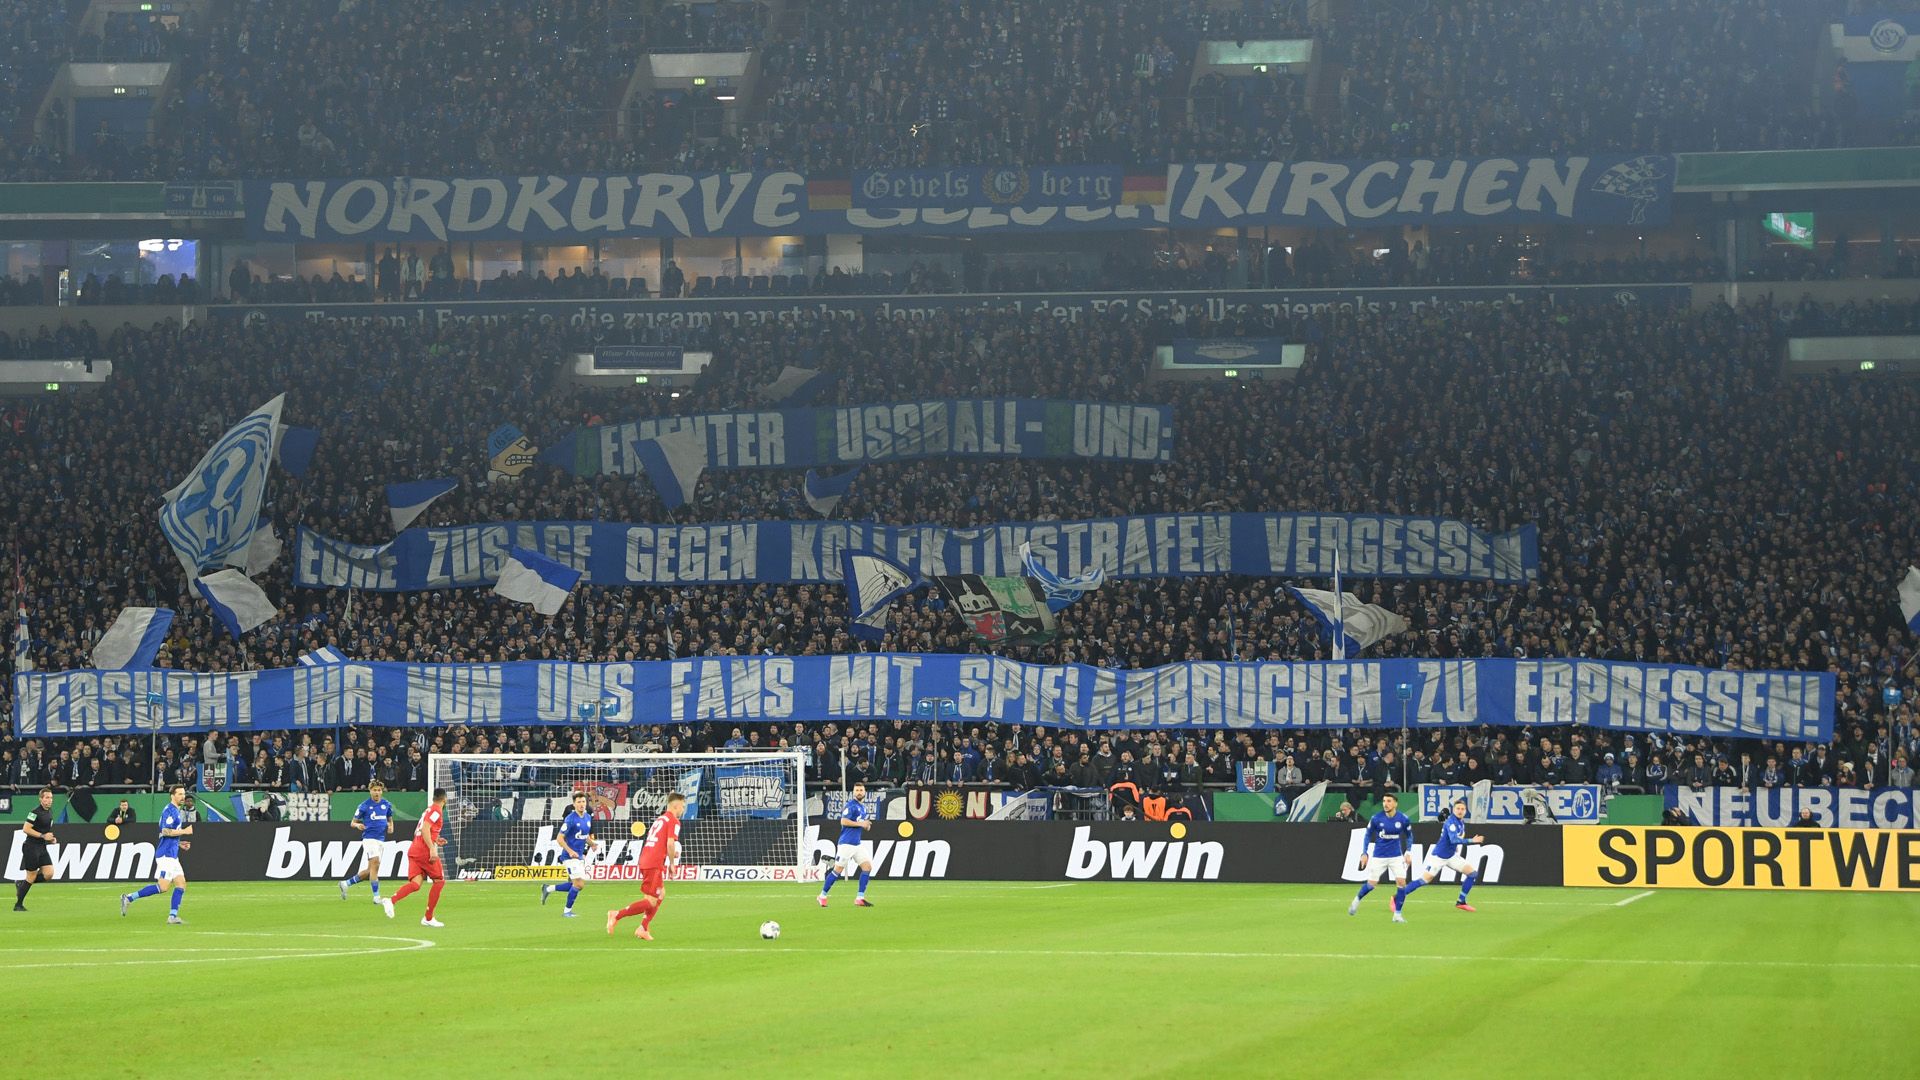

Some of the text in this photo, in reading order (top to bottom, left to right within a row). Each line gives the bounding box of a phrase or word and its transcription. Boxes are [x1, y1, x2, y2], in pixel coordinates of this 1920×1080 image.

[1040, 169, 1112, 200] berg
[264, 172, 805, 240] NORDKURVE
[625, 523, 758, 583] GEGEN
[17, 669, 258, 734] VERSUCHT
[293, 664, 374, 725] IHR
[406, 664, 502, 725] NUN
[537, 662, 634, 724] UNS
[670, 658, 795, 721] FANS
[828, 656, 922, 717] MIT
[1416, 660, 1477, 723] ZU
[1514, 661, 1821, 737] ERPRESSEN!
[288, 792, 329, 807] BLUE
[1426, 789, 1437, 813] Die
[1437, 789, 1572, 816] KRE
[1677, 787, 1920, 828] NEUBEC
[1065, 822, 1224, 880] bwin
[457, 867, 492, 880] bwin
[595, 867, 697, 880] BAUUS
